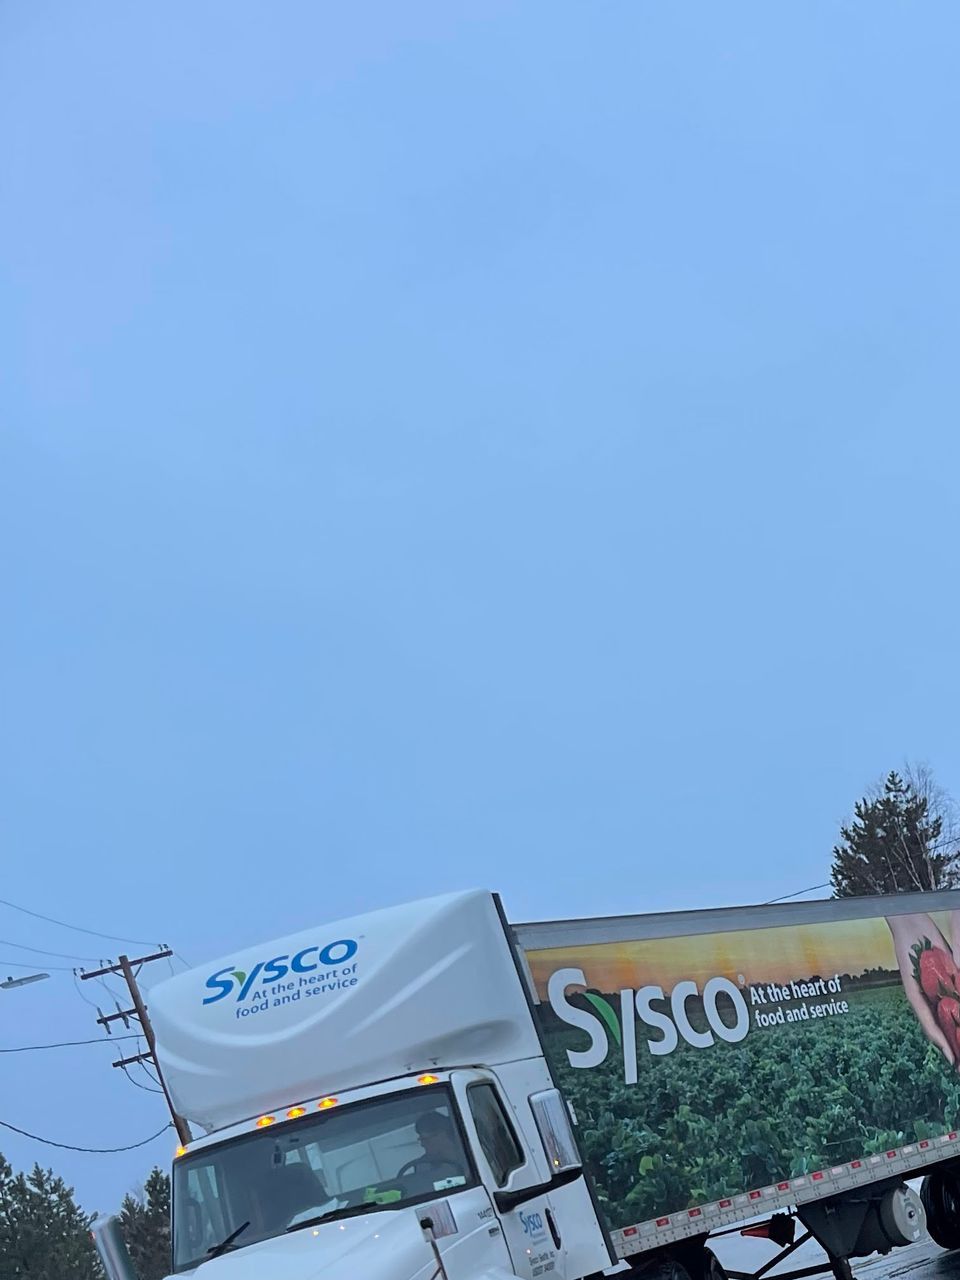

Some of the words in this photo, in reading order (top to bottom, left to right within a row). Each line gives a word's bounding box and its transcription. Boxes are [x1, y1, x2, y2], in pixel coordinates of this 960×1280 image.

[202, 939, 358, 1005] Sysco
[251, 991, 268, 1002] At
[271, 981, 295, 996] the
[299, 968, 338, 987] heart
[342, 963, 358, 976] of
[750, 986, 767, 1005] At
[767, 983, 791, 1002] the
[790, 979, 828, 999] heart
[828, 974, 841, 993] of
[235, 1000, 269, 1019] food
[273, 989, 300, 1007] and
[305, 977, 359, 997] service
[755, 1006, 786, 1027] food
[786, 1003, 809, 1022] and
[810, 999, 849, 1018] service
[547, 967, 750, 1085] Sysco
